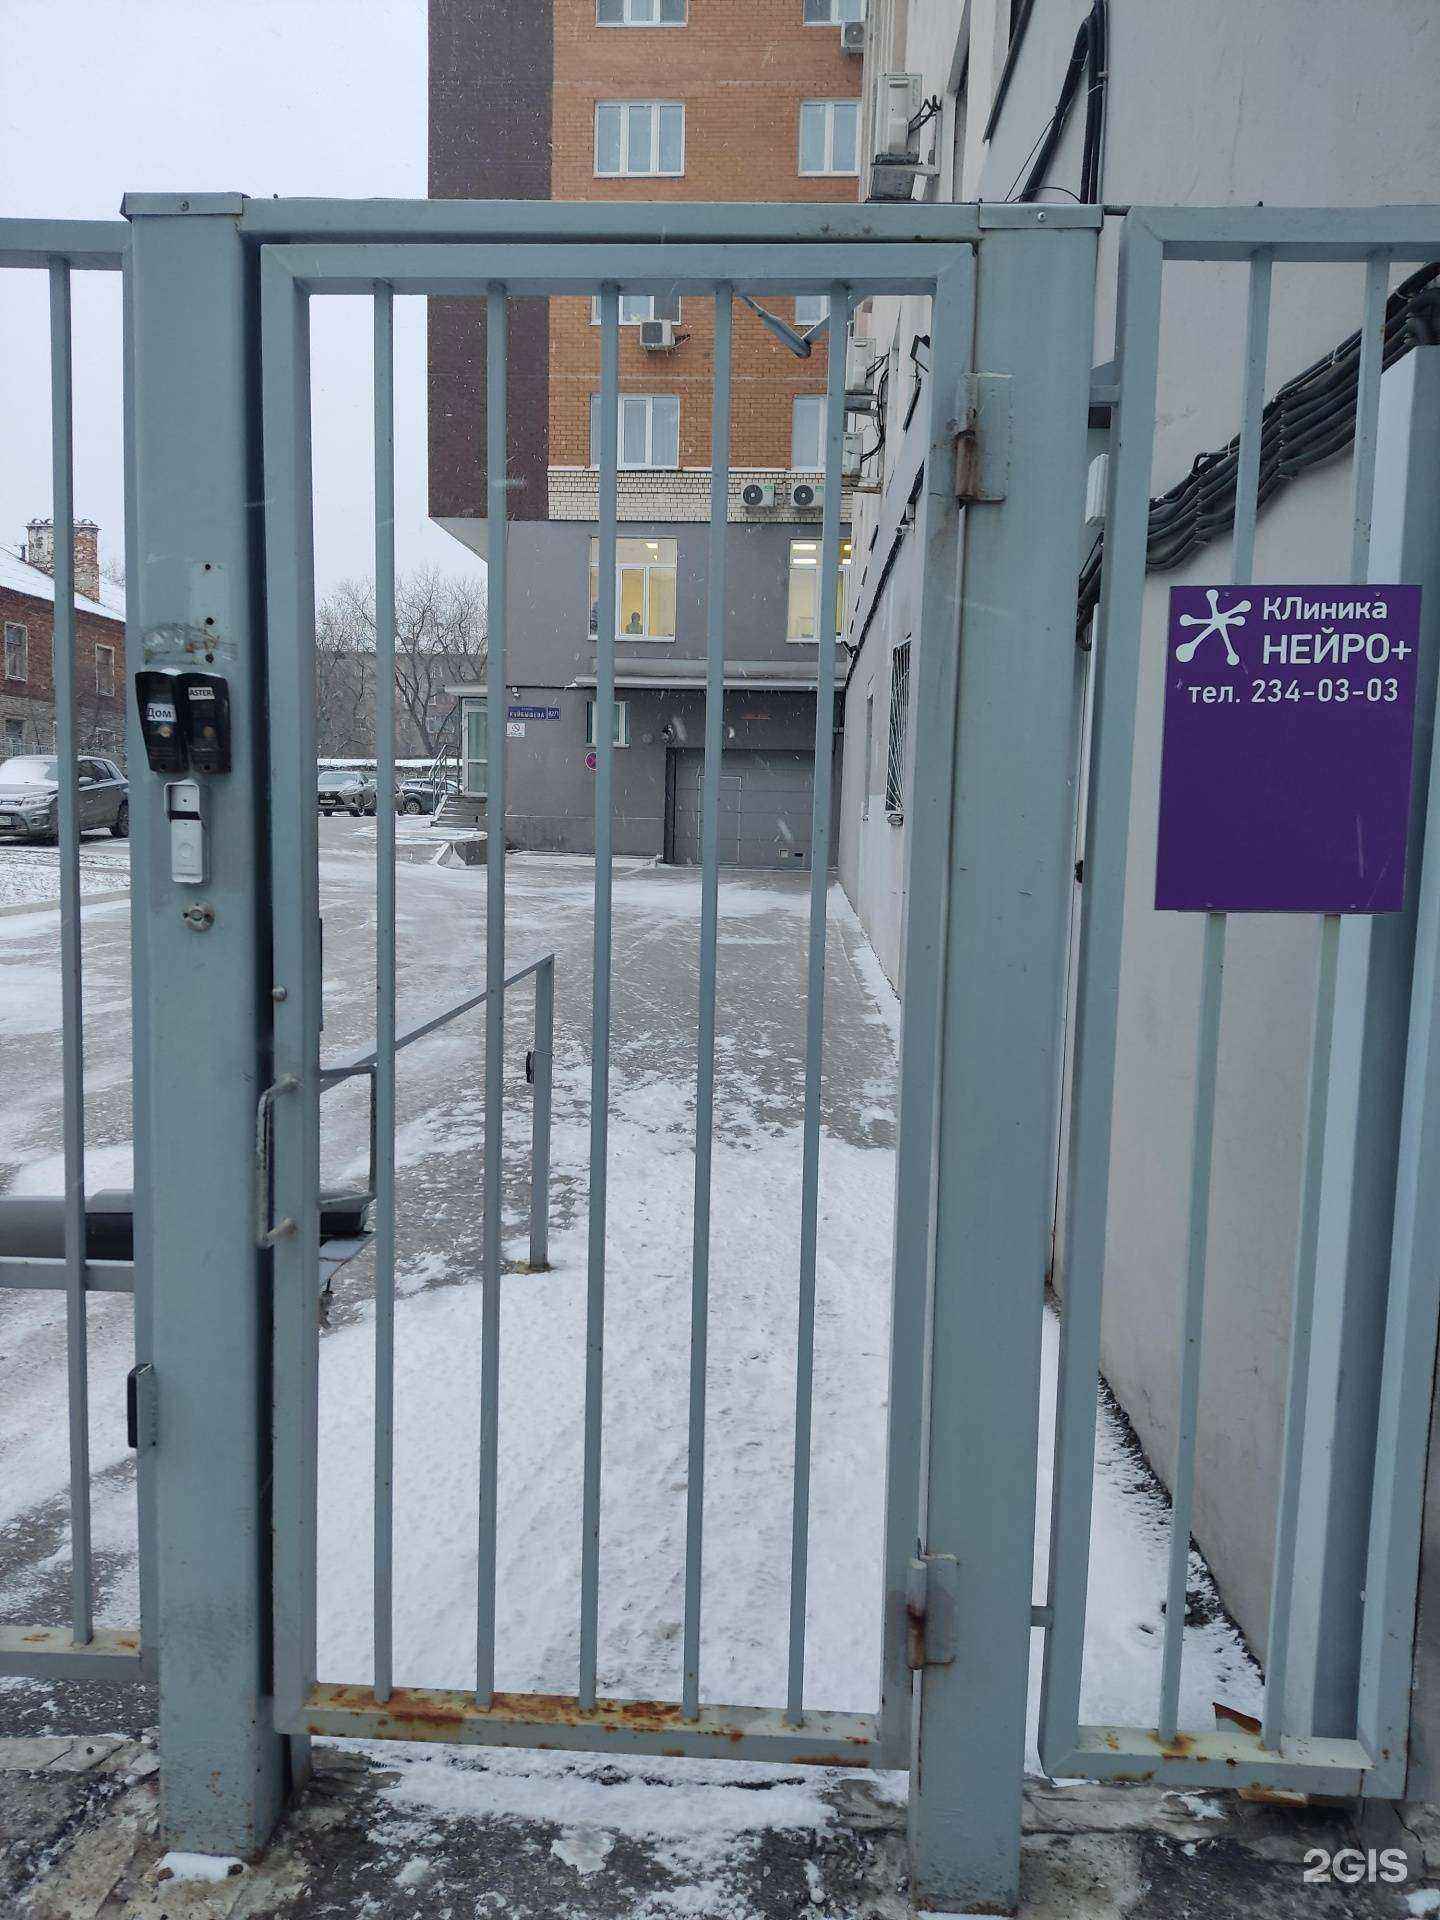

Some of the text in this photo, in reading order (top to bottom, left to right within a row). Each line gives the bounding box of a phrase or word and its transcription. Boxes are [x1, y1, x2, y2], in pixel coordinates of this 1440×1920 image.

[1262, 626, 1412, 664] НЕЙРО+
[1188, 678, 1399, 704] тел. 234-03-03
